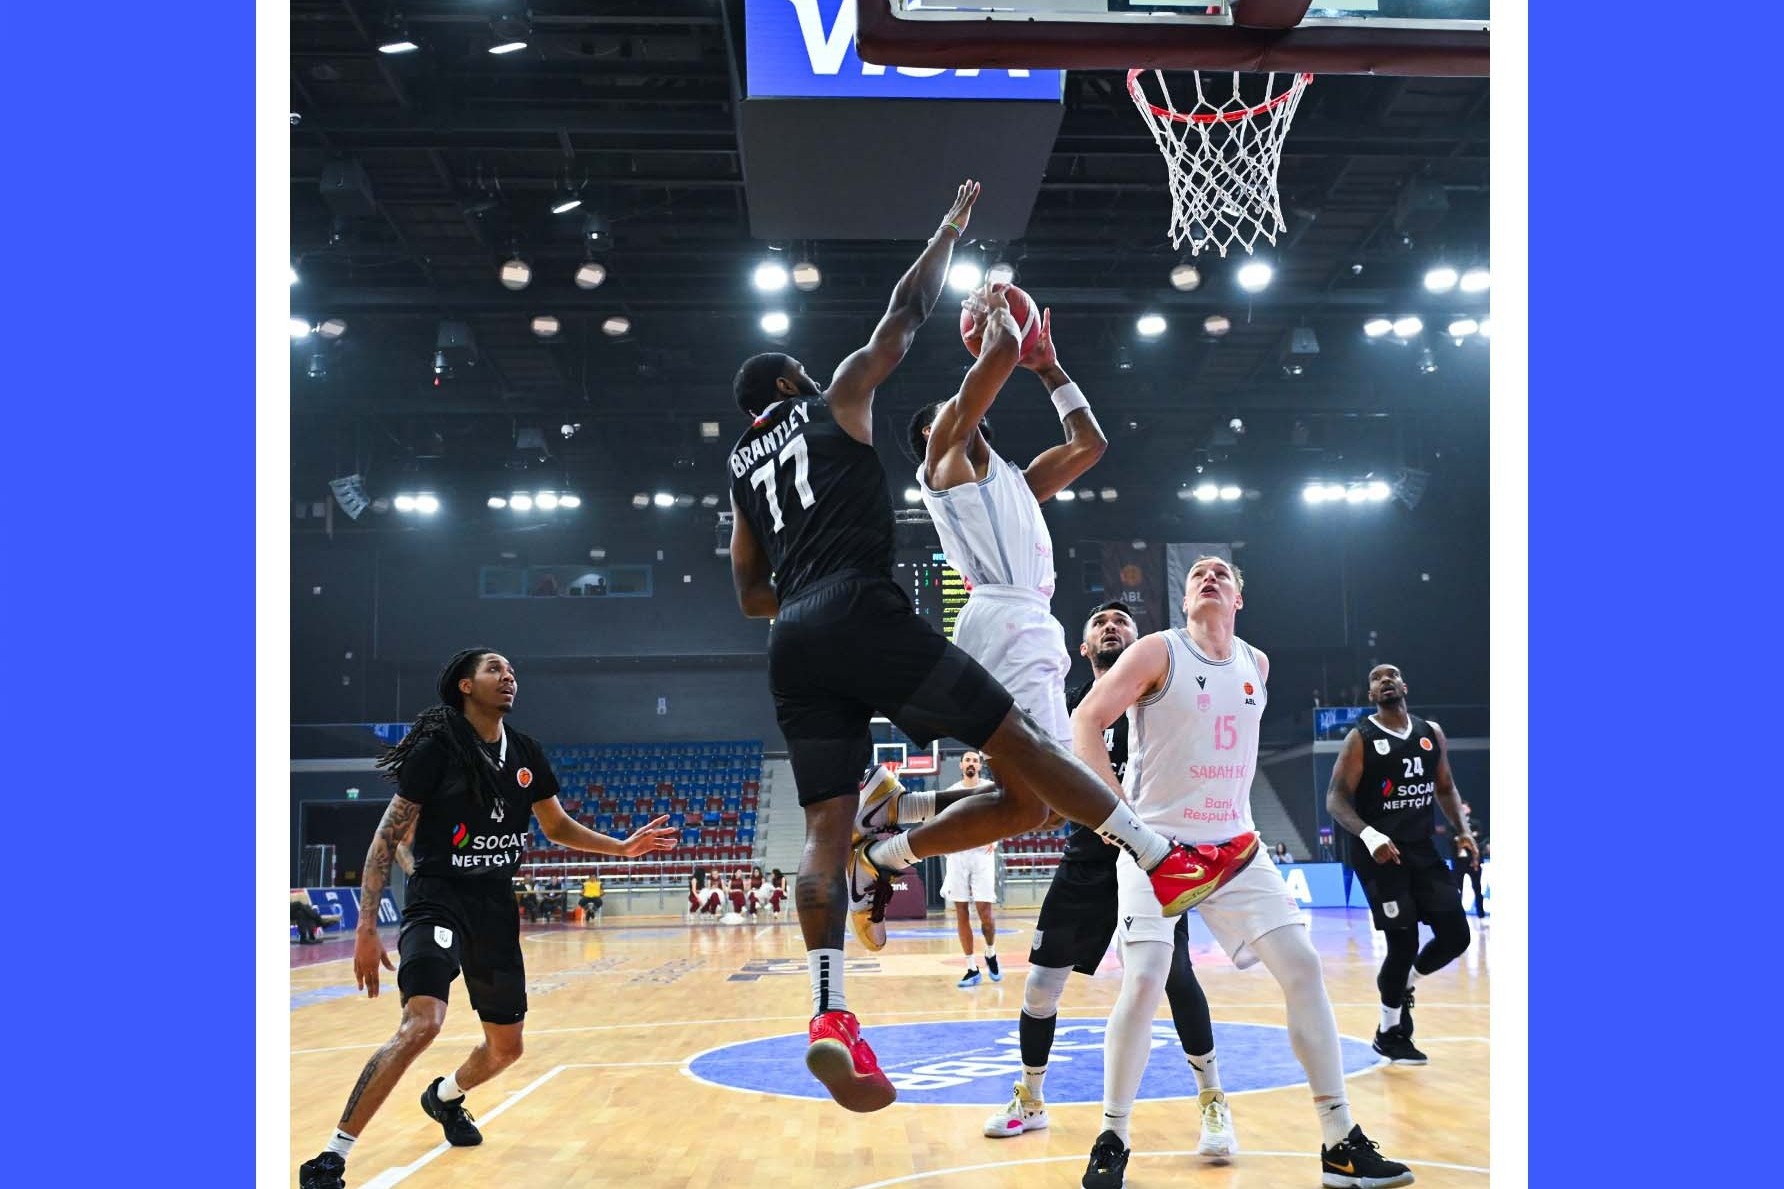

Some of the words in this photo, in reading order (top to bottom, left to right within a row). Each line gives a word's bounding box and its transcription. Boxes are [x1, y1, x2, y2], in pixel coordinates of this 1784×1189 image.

[730, 402, 810, 479] BRANTLEY
[750, 433, 816, 534] 77
[1120, 591, 1145, 602] ABL
[1214, 715, 1238, 750] 15
[1190, 764, 1233, 779] SABAH
[1402, 756, 1424, 778] 24
[490, 798, 505, 823] 4
